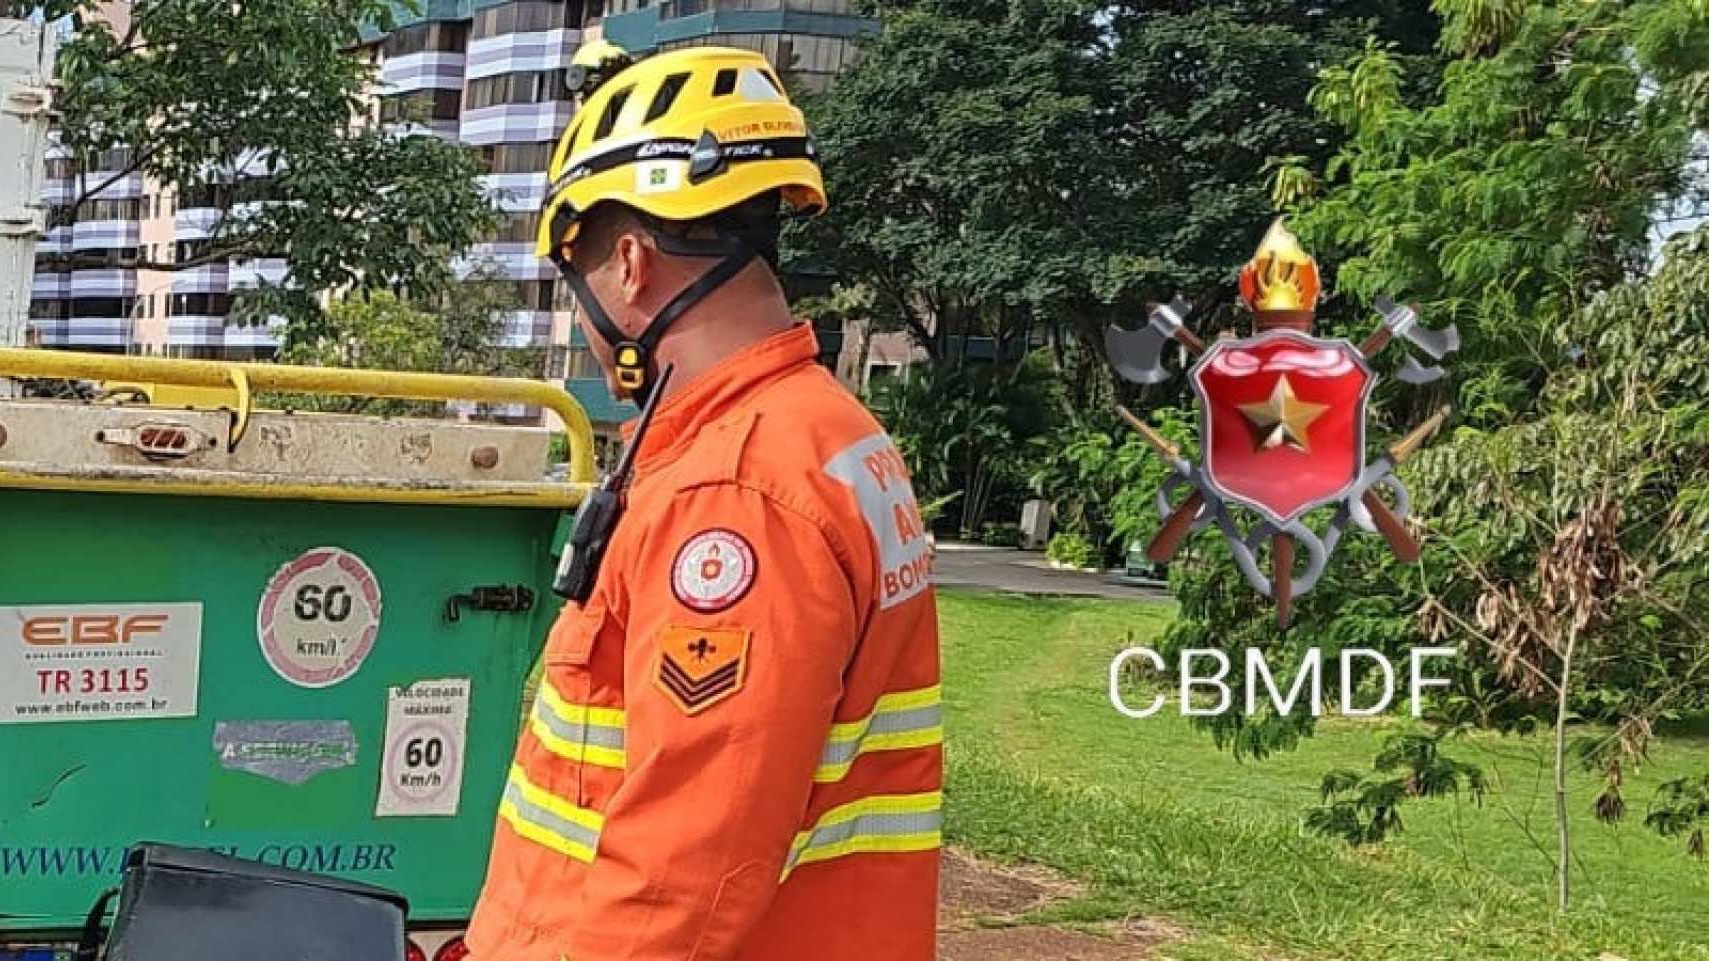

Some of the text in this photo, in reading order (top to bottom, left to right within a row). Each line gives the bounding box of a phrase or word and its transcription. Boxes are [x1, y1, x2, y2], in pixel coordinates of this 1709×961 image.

[294, 583, 353, 622] 60
[21, 613, 169, 646] EBF
[36, 666, 150, 695] TR 3115
[14, 698, 169, 715] www.ebfweb.com.br
[405, 736, 443, 768] 60
